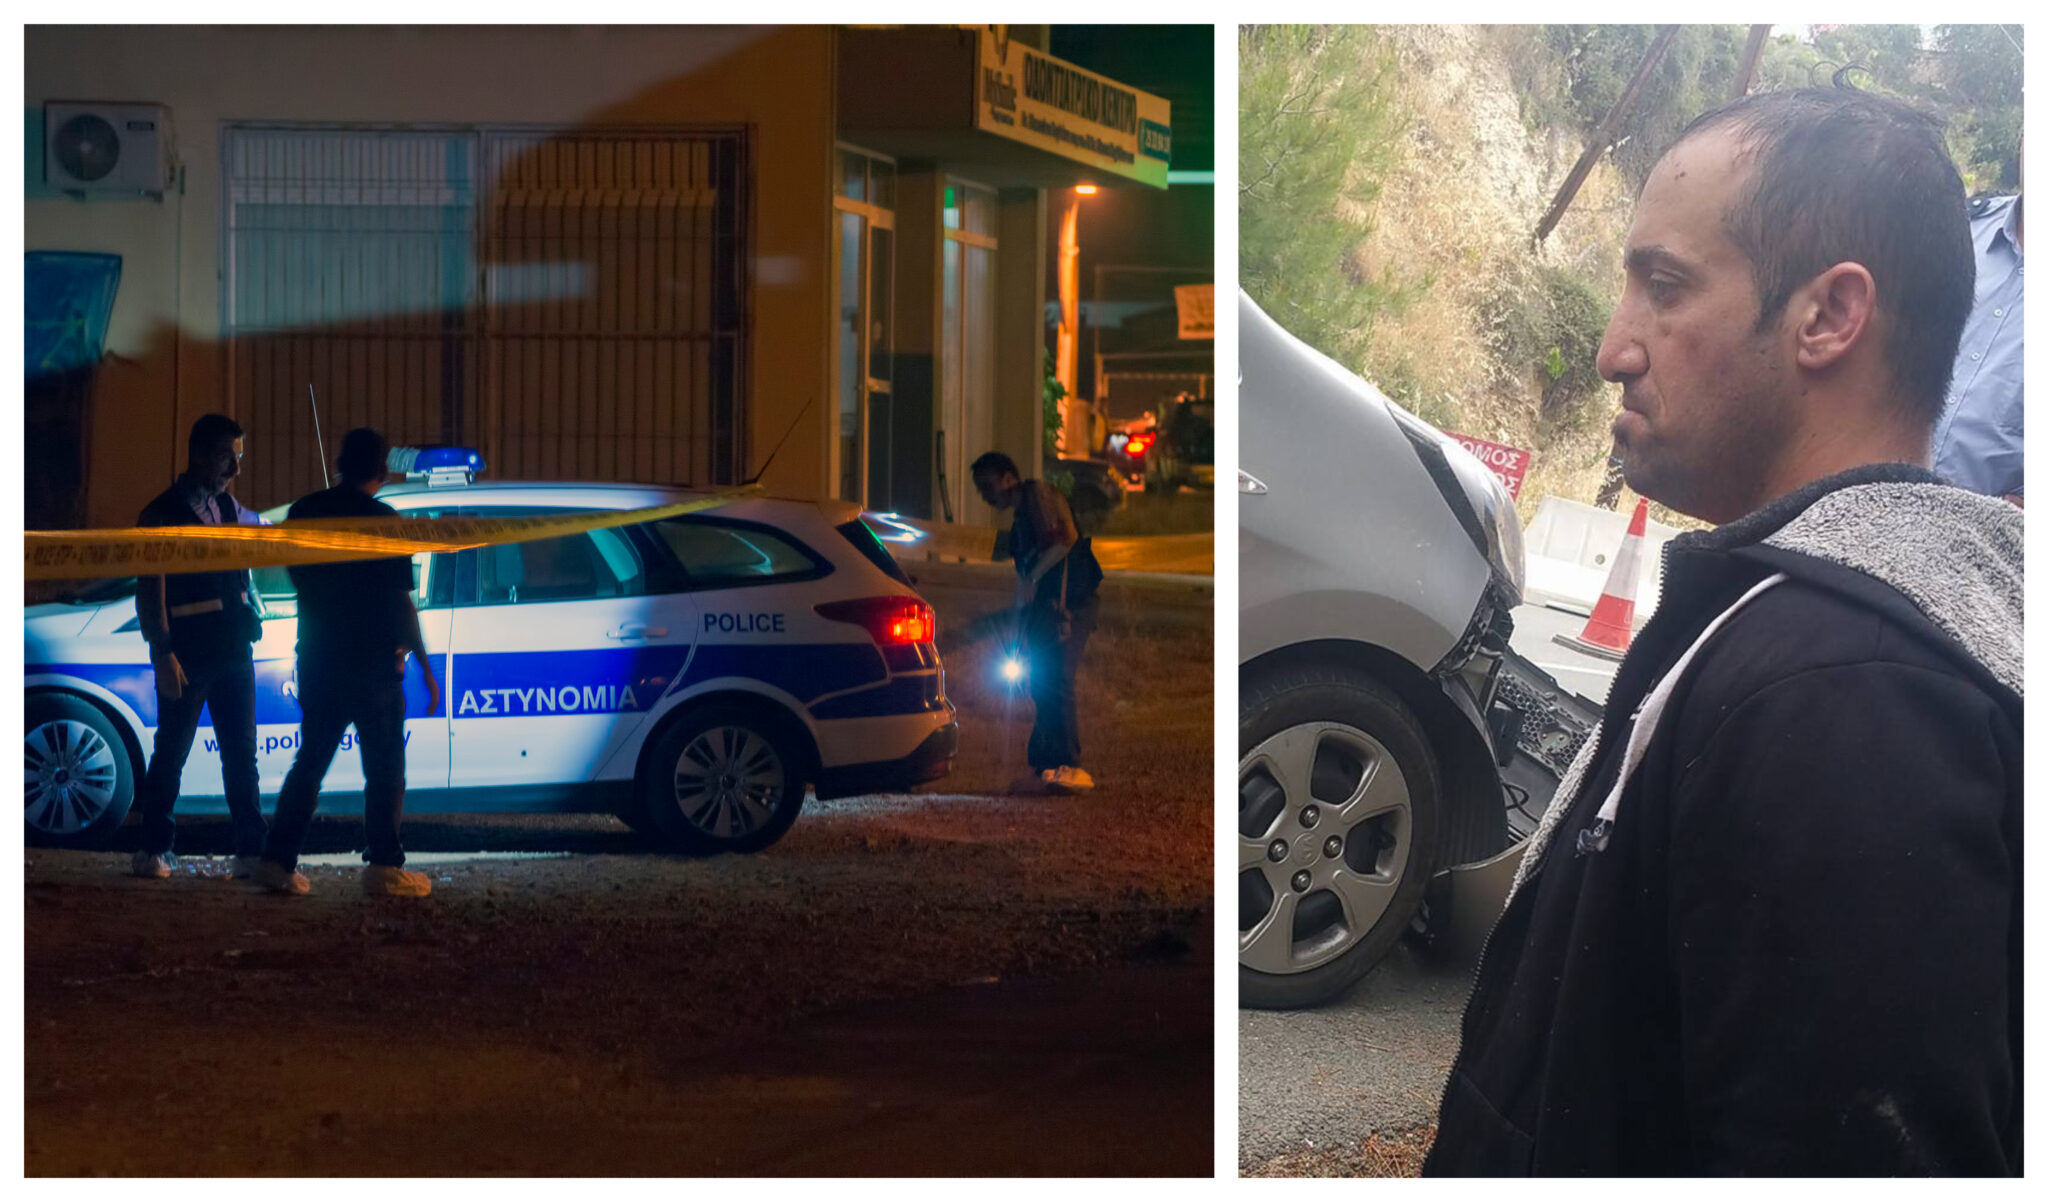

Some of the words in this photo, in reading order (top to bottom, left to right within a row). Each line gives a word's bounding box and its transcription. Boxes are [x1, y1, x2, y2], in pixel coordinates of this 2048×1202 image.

[1459, 441, 1520, 470] ΟΜΟΣ
[704, 613, 785, 633] POLICE
[458, 685, 638, 715] ΑΣΤΥΝΟΜΙΑ
